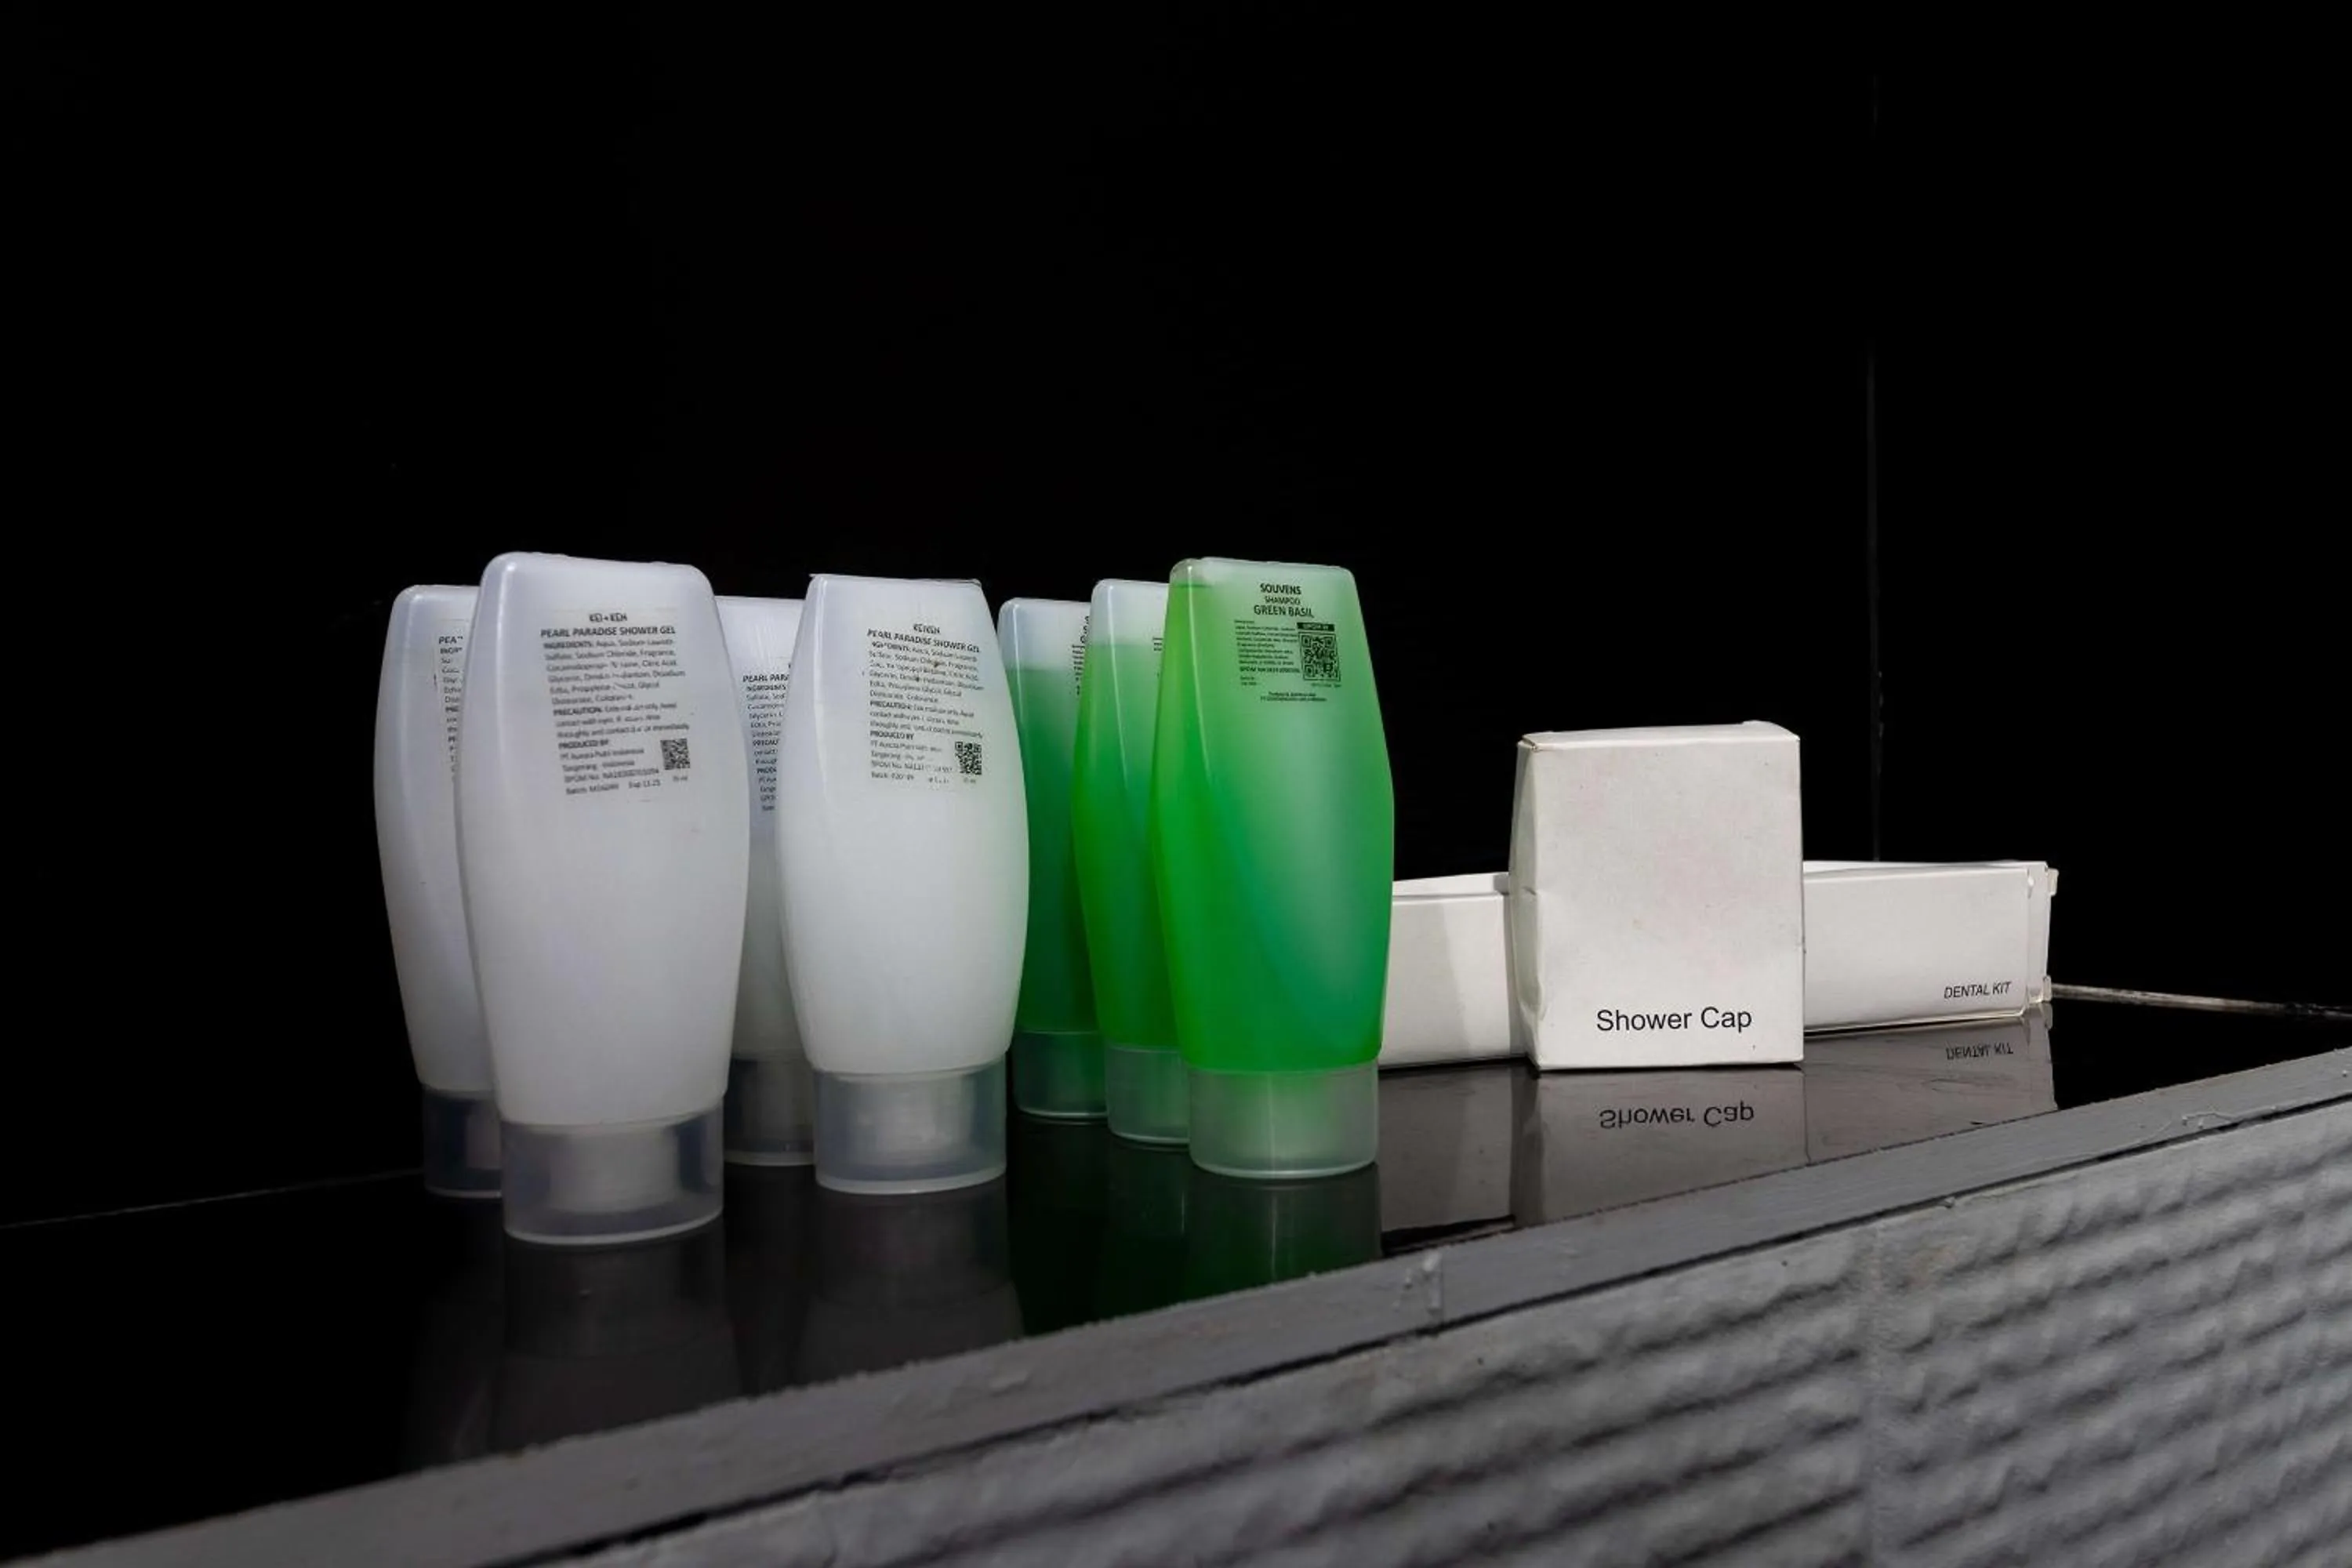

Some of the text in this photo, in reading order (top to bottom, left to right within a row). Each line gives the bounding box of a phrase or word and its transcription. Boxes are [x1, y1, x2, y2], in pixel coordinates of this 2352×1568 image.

[1260, 583, 1301, 594] SOUVENS
[1265, 596, 1301, 605] SHAMPOO
[1254, 605, 1314, 618] GREEN BASIL
[541, 629, 570, 637] PEARL
[572, 627, 617, 637] PARADISE
[619, 626, 658, 635] SHOWER
[867, 629, 980, 653] PEARL PARADISE SHOWER GEL
[1944, 982, 2012, 999] DENTAL KIT
[1597, 1006, 1752, 1033] Shower Cap
